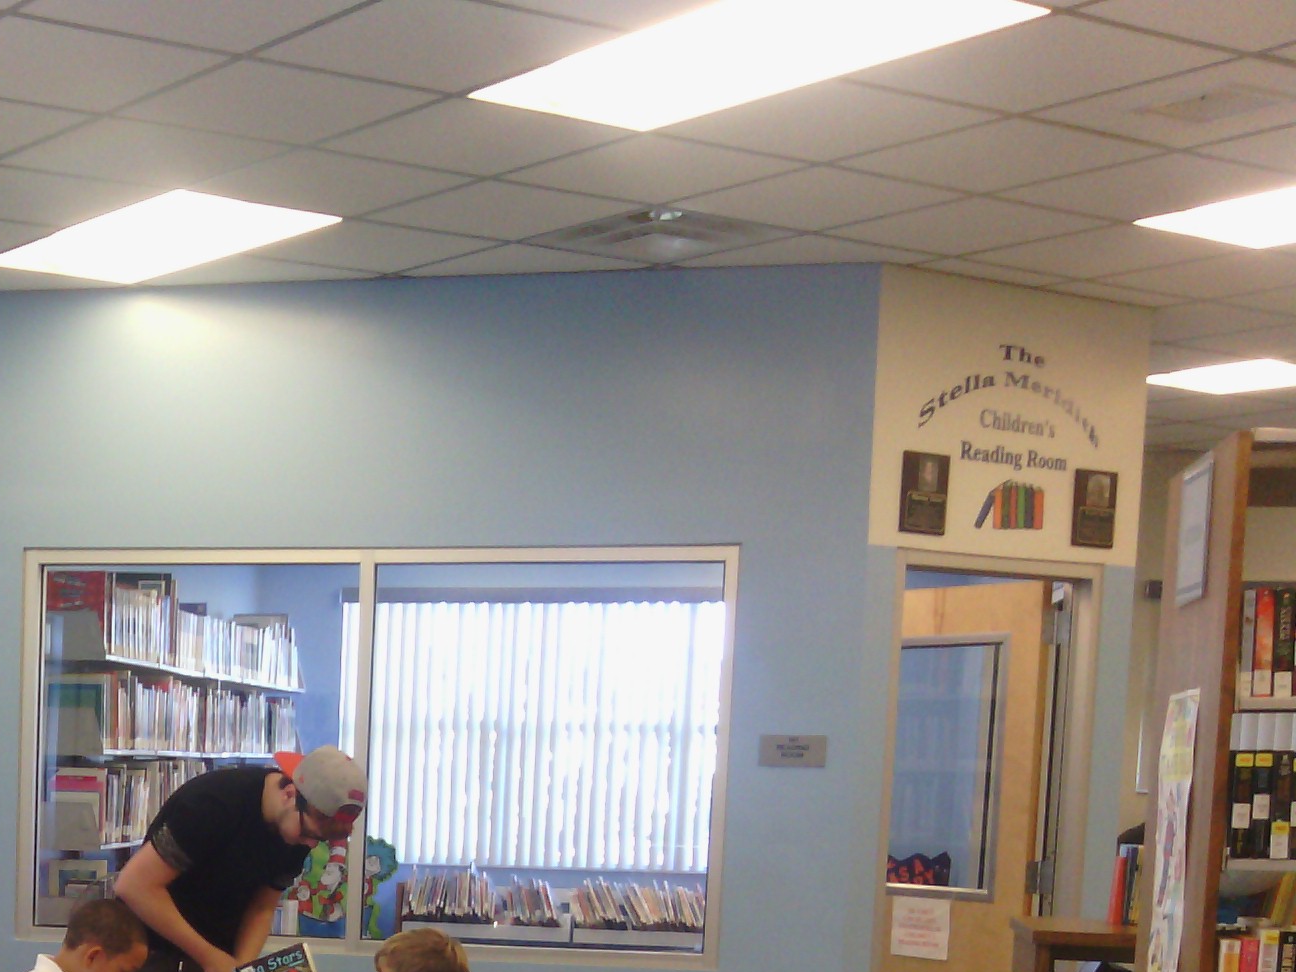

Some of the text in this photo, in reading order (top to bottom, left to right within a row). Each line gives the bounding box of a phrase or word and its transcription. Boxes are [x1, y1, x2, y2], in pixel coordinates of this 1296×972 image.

[1000, 344, 1045, 367] The
[917, 373, 996, 428] Stella
[979, 408, 1055, 438] Children's
[960, 440, 1067, 471] Reading Room
[267, 950, 303, 971] Stars
